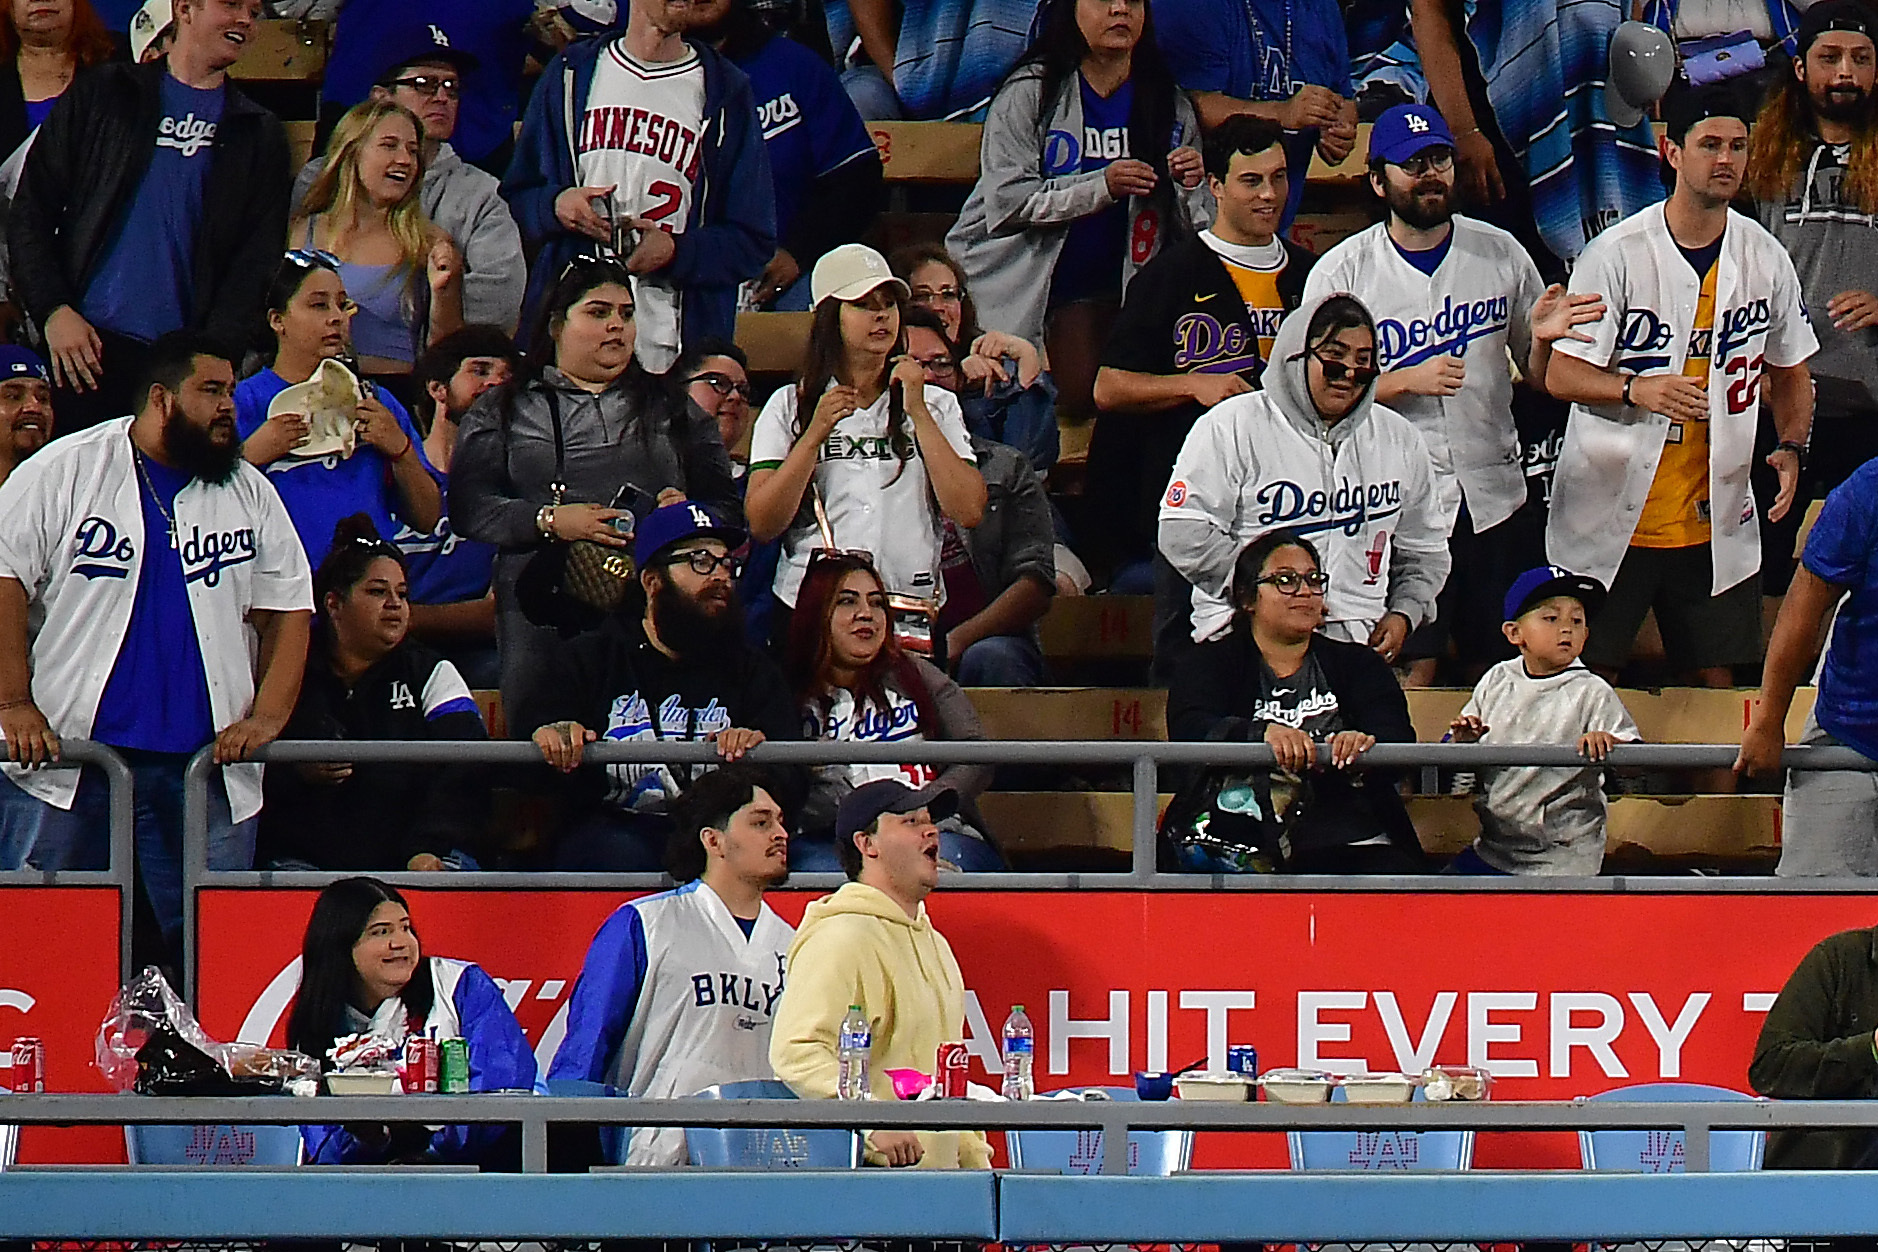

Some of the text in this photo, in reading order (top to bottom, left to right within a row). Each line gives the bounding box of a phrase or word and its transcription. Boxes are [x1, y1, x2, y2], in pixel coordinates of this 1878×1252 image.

[1404, 114, 1429, 132] LA
[1174, 312, 1248, 369] Do
[1379, 294, 1508, 366] Dodgers
[688, 505, 712, 527] LA
[1256, 476, 1401, 536] Dodgers
[390, 680, 416, 709] LA
[1113, 700, 1142, 736] 14
[1049, 990, 1256, 1076] HIT
[1297, 991, 1711, 1078] EVERY
